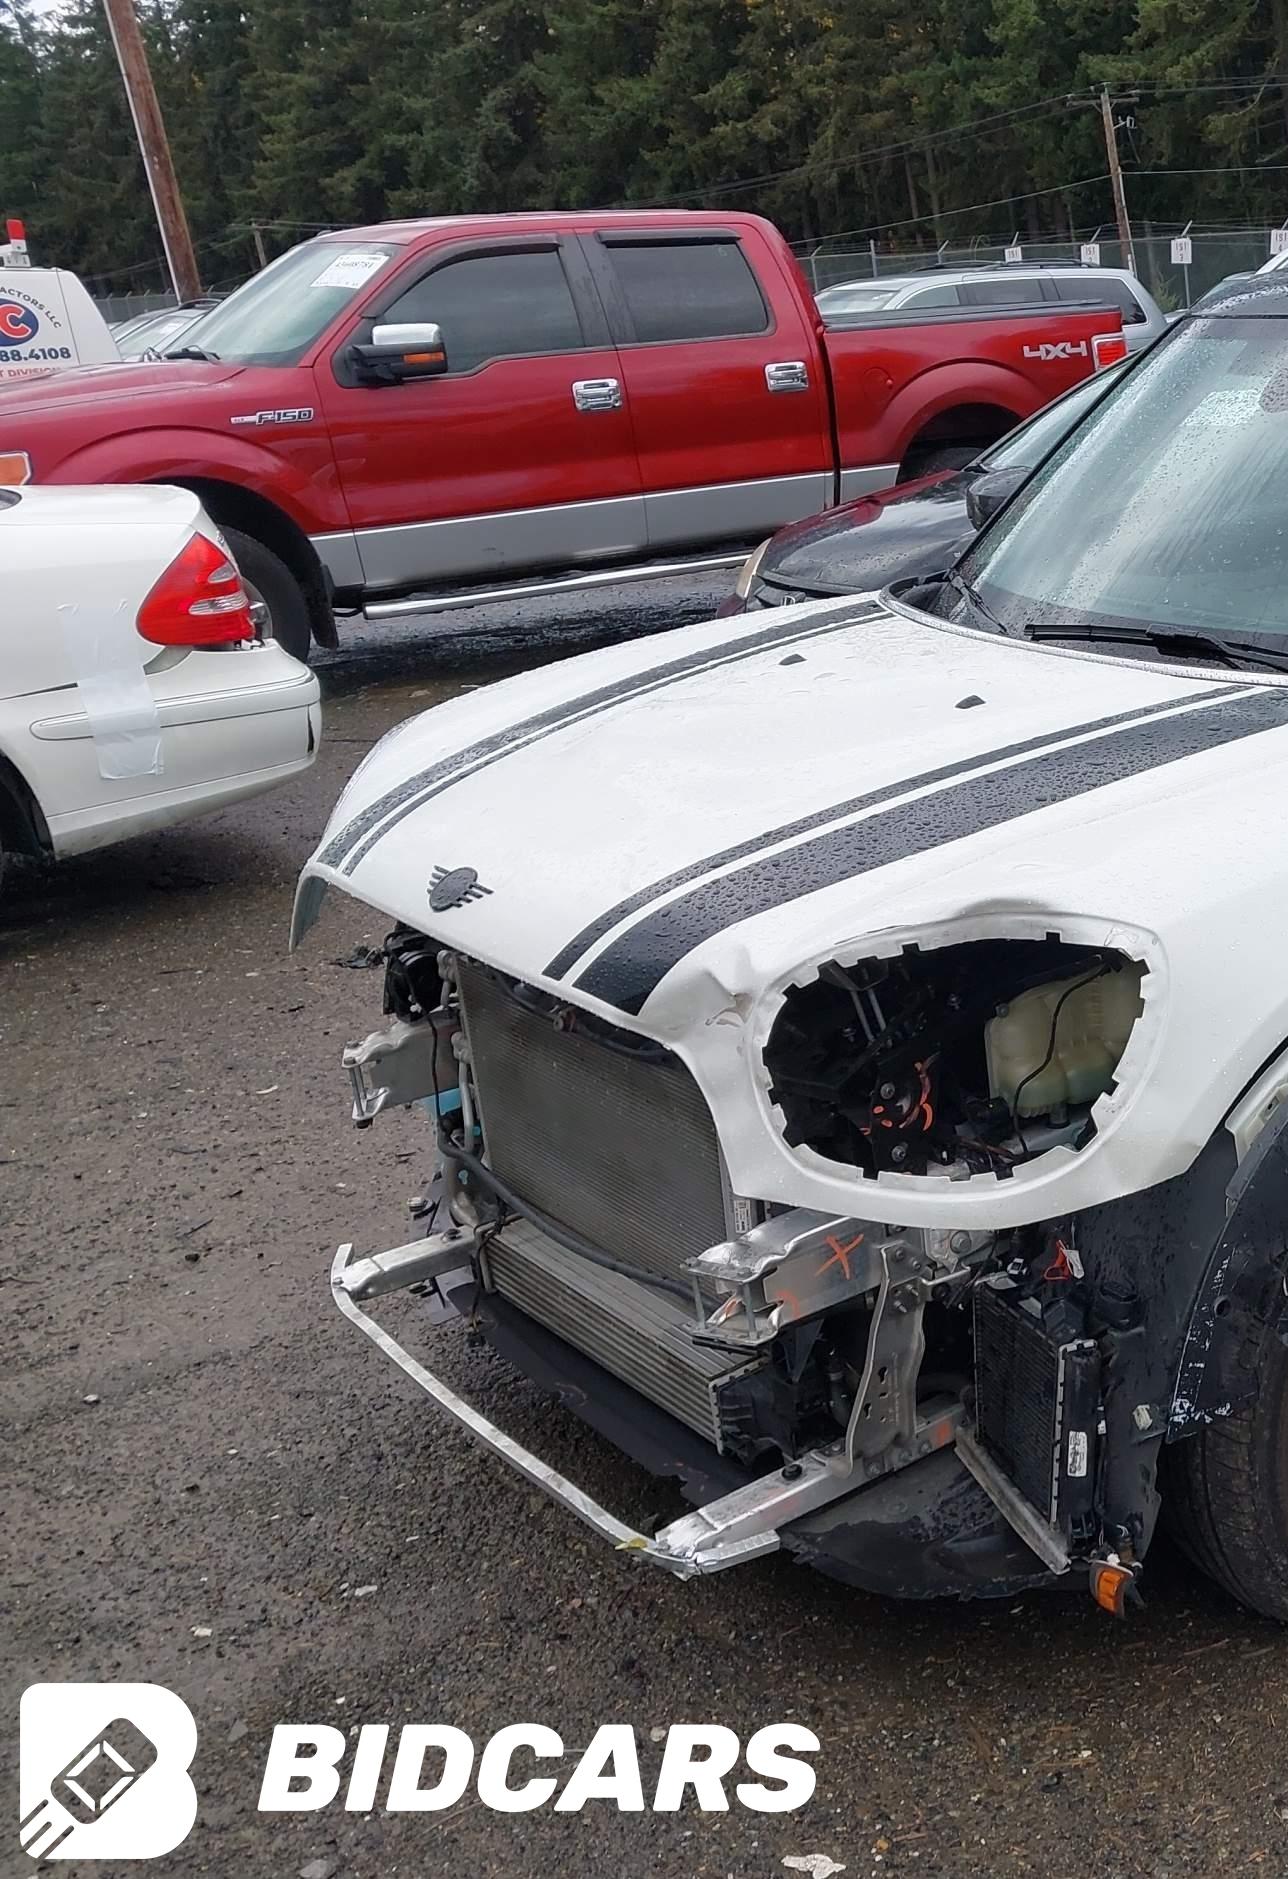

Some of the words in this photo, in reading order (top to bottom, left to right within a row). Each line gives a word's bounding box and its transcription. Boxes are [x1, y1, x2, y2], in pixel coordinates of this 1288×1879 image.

[44, 310, 62, 329] LLC
[1023, 340, 1088, 361] 4X4
[256, 407, 314, 425] F-150
